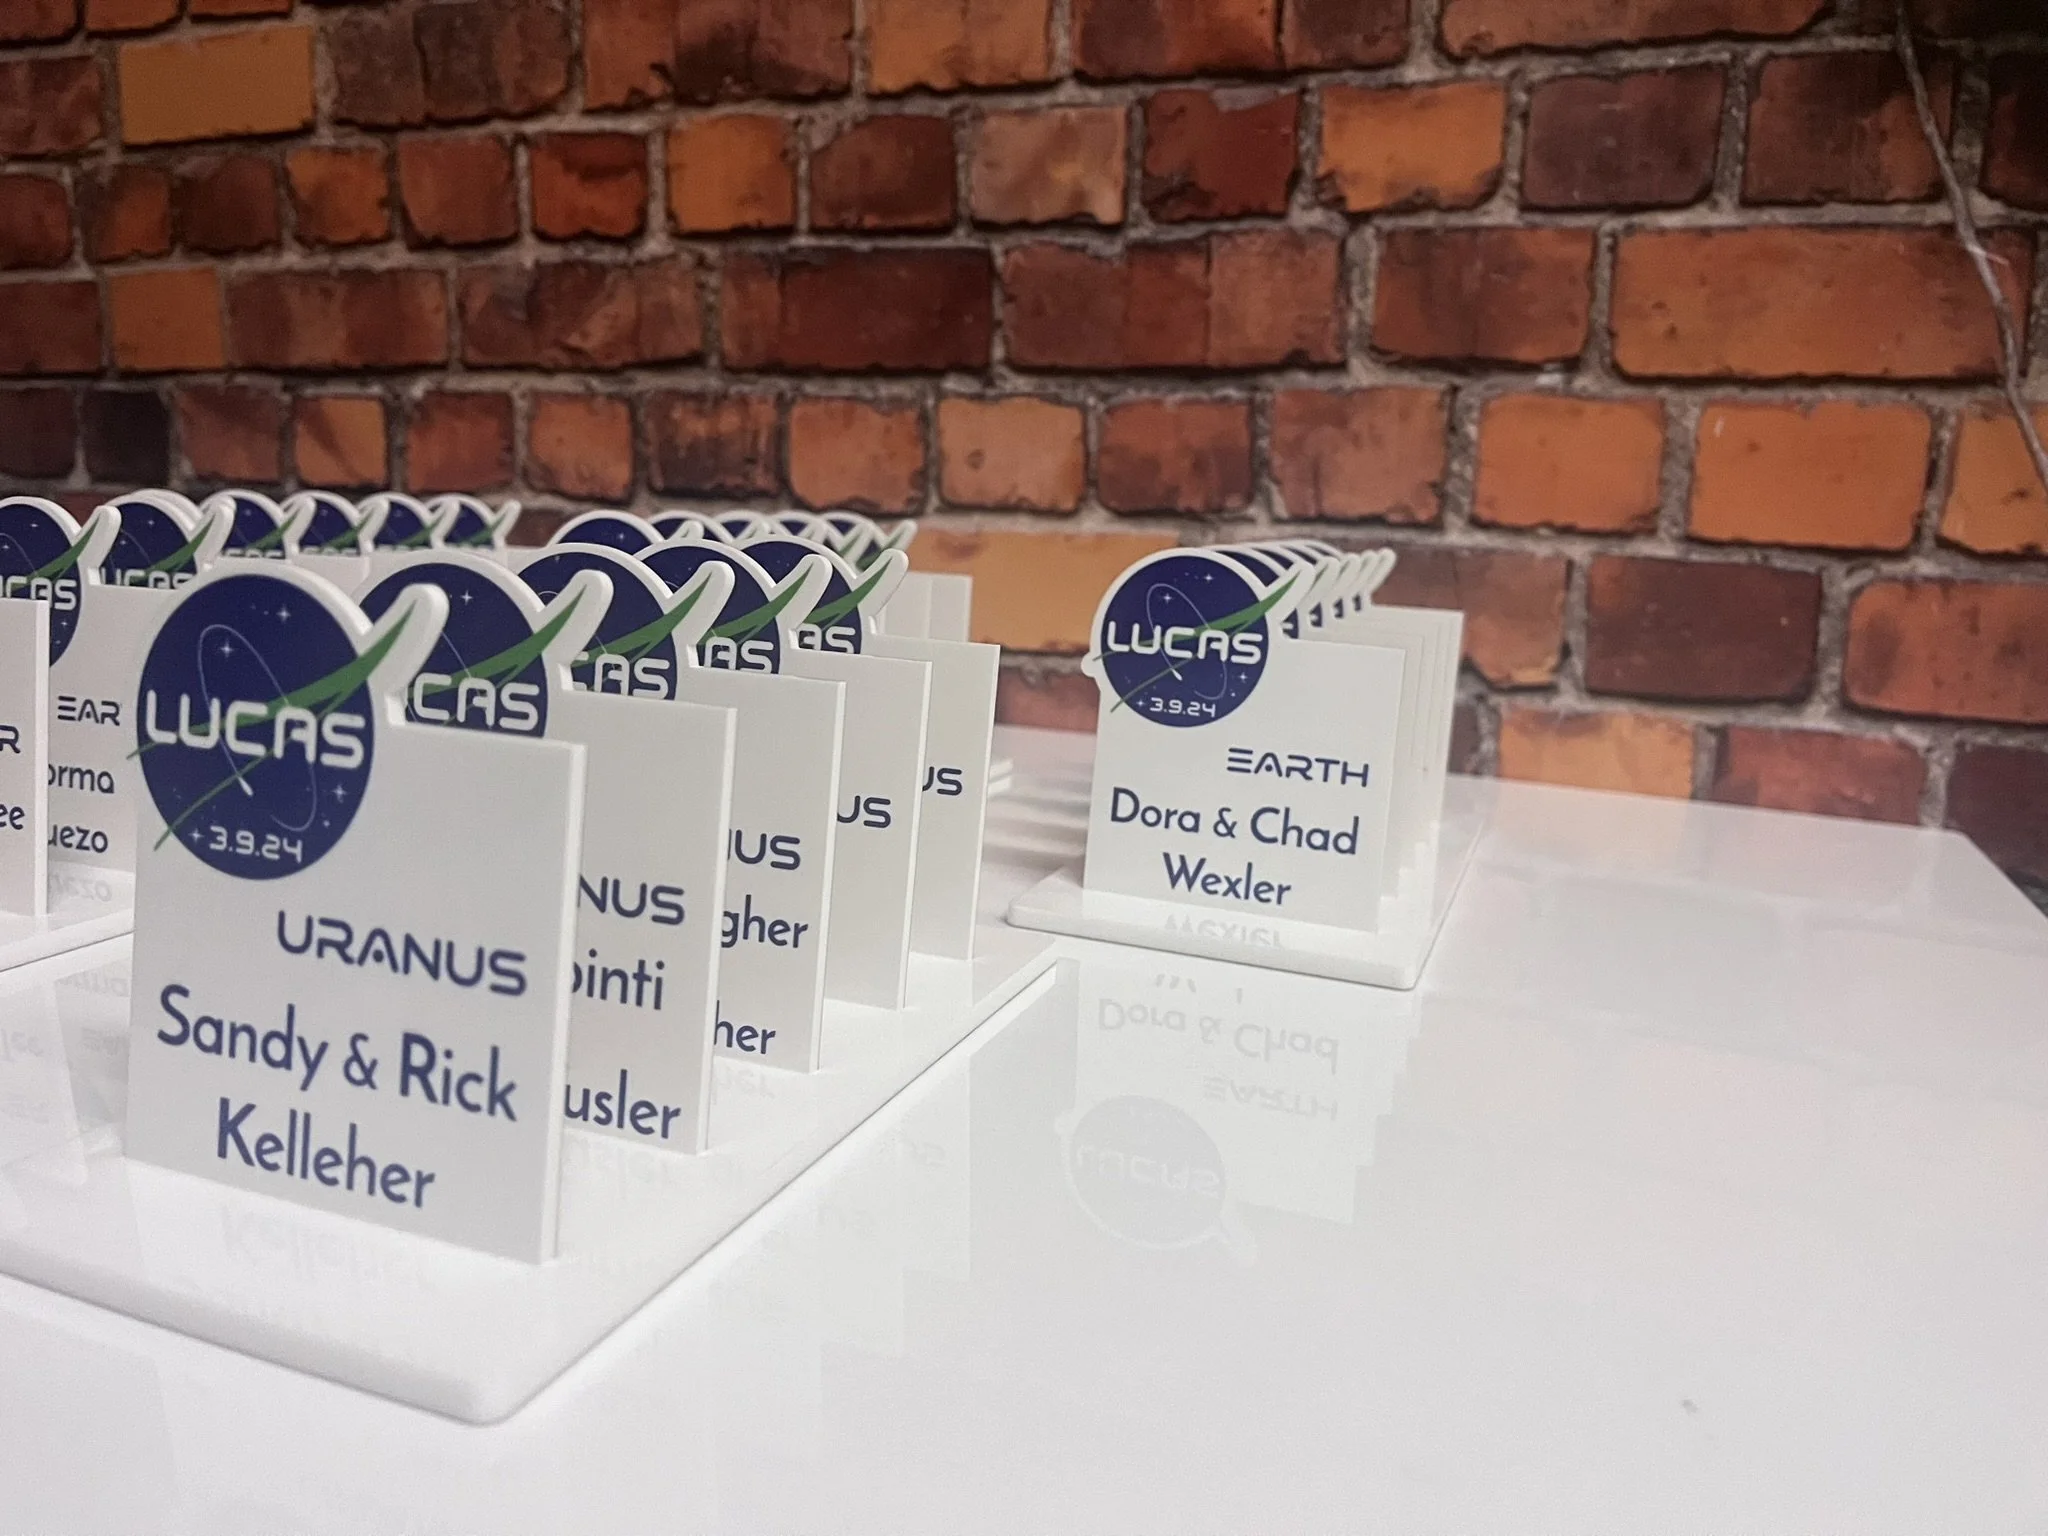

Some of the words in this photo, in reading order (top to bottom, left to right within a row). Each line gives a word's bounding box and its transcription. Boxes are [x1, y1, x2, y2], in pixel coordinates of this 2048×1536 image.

[1107, 620, 1263, 665] LUCAS
[145, 689, 366, 769] LUCAS
[413, 672, 540, 731] CAS
[1150, 697, 1217, 717] 3.9.24
[1226, 747, 1369, 787] EARTH
[209, 825, 304, 863] 3.9.24
[1111, 786, 1200, 833] Dora
[1213, 807, 1238, 839] &
[1250, 806, 1359, 855] Chad
[1162, 851, 1292, 905] Wexler
[277, 909, 528, 997] URANUS
[157, 983, 329, 1092] Sandy
[343, 1032, 379, 1090] &
[399, 1031, 518, 1122] Rick
[217, 1096, 436, 1208] Kelleher
